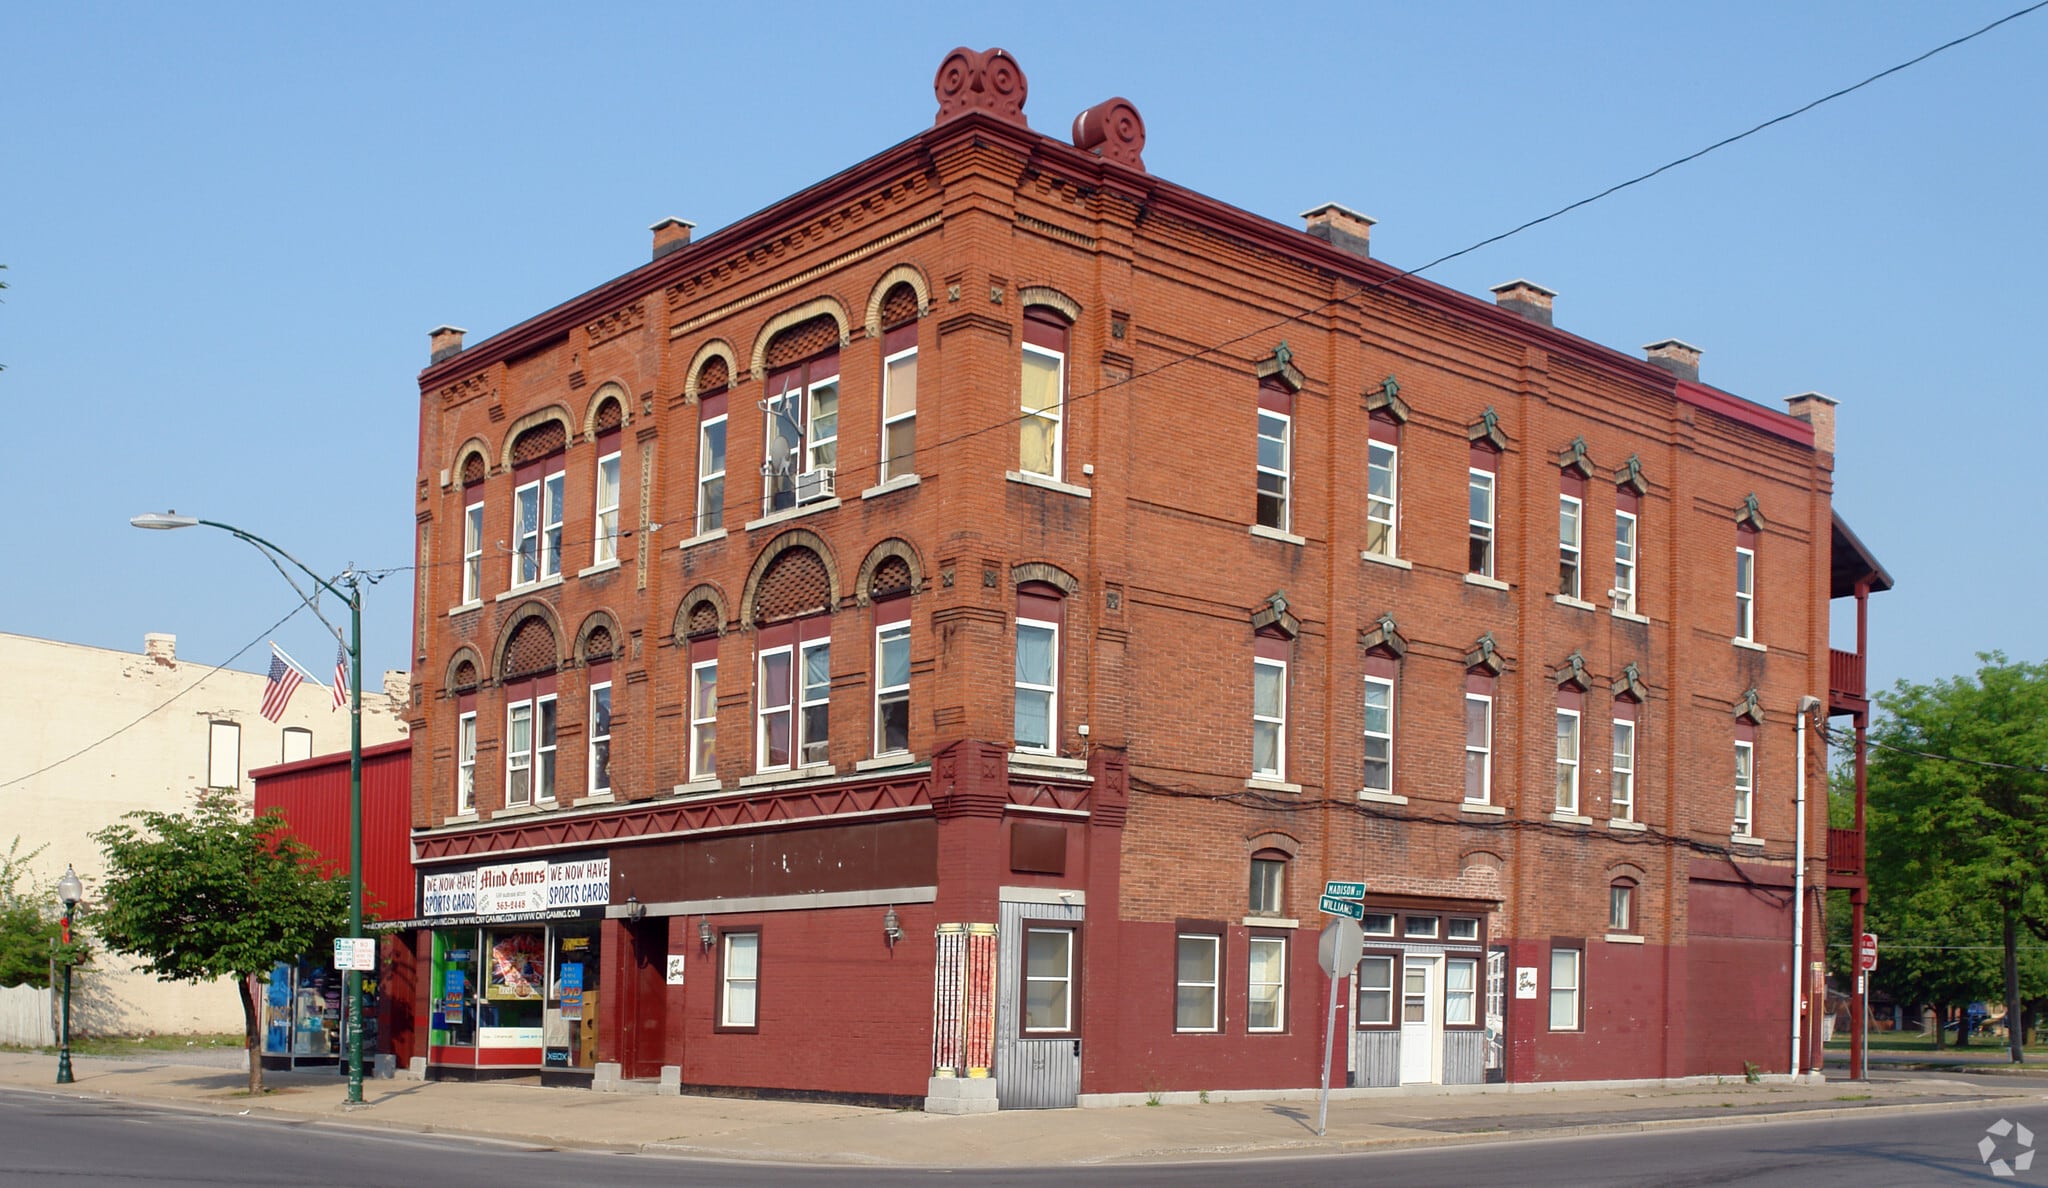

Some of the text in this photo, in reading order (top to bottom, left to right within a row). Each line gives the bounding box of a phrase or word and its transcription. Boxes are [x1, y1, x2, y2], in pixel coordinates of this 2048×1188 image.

[480, 867, 546, 891] Mind Games
[550, 862, 608, 881] WE NOW HAVE
[427, 874, 476, 892] WE NOW HAVE
[1327, 885, 1356, 896] MADISON
[425, 894, 451, 913] SPORTS
[452, 892, 476, 911] CARDS
[548, 884, 580, 905] SPORTS
[581, 882, 609, 903] CARDS
[1323, 898, 1354, 916] WILLIAMS
[562, 987, 581, 997] DVD
